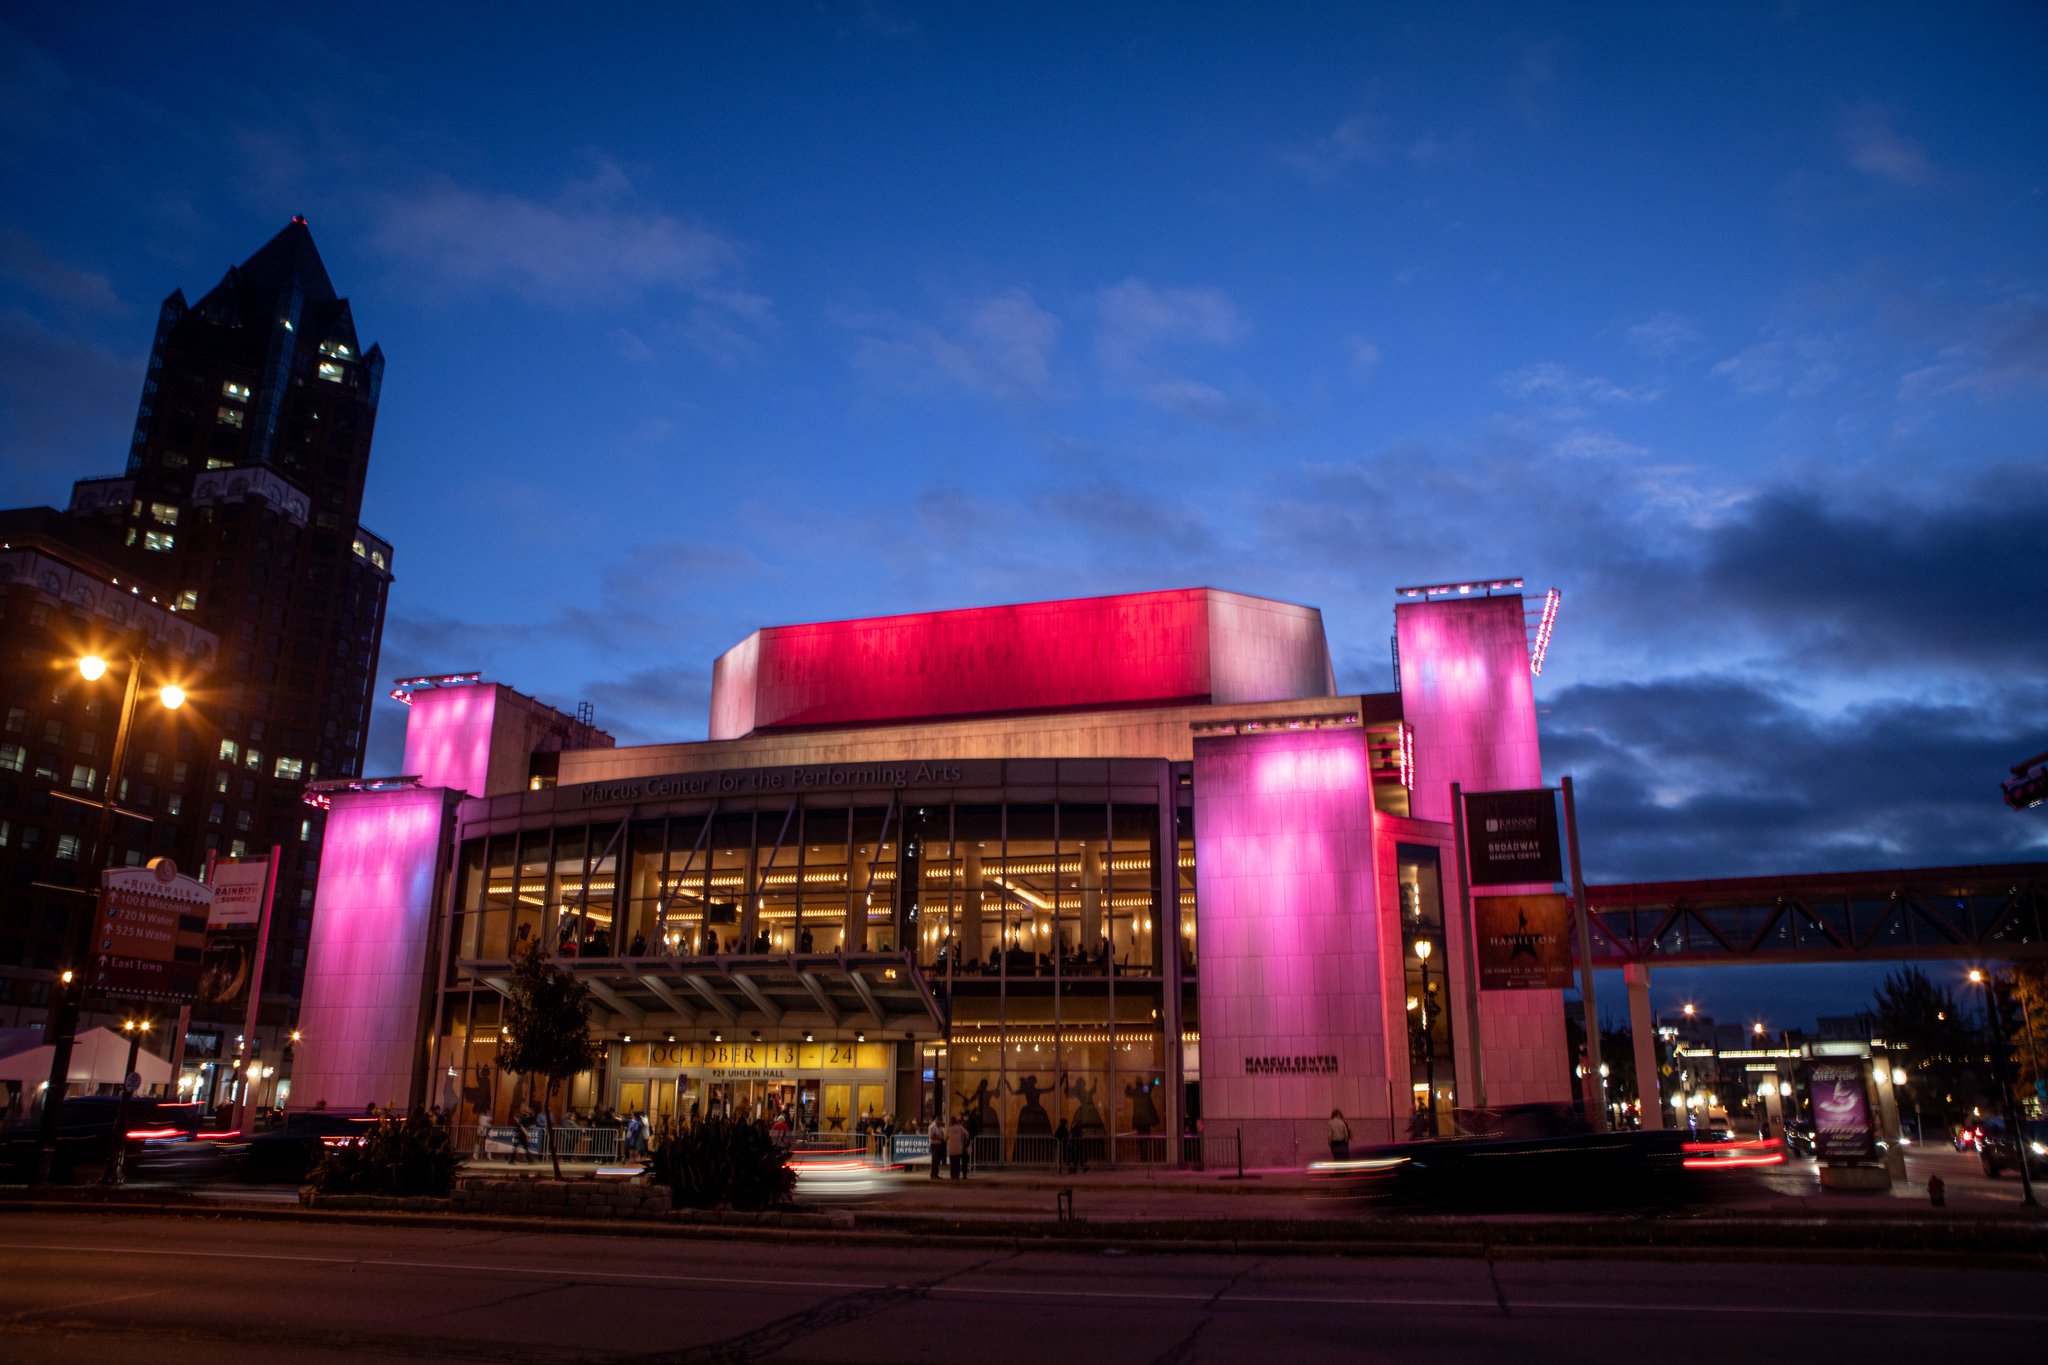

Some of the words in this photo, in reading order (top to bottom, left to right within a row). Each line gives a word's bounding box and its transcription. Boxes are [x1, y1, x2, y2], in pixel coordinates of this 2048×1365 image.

[580, 783, 641, 803] Marcus
[647, 777, 711, 797] Center
[717, 772, 745, 790] for
[751, 769, 784, 789] the
[791, 765, 908, 788] Performing
[915, 761, 961, 781] Arts
[1488, 841, 1539, 852] BROADWAY
[1489, 853, 1515, 861] MARCUS
[1517, 852, 1541, 860] CENTER
[131, 879, 192, 898] RIVERWALK
[215, 887, 260, 896] RAINBOW
[121, 894, 139, 906] 100
[140, 896, 147, 907] E
[148, 898, 191, 913] Wisconsin
[119, 909, 137, 920] 720
[138, 911, 146, 922] N
[147, 912, 174, 926] Water
[115, 925, 134, 937] 525
[136, 927, 144, 938] N
[145, 928, 172, 941] Water
[1490, 936, 1557, 946] HAMILTON
[110, 957, 134, 969] East
[136, 960, 163, 973] Town
[652, 1047, 757, 1064] OCTOBER
[773, 1047, 794, 1063] 13
[829, 1047, 853, 1063] 24
[1245, 1056, 1291, 1066] MARCUS
[1294, 1056, 1338, 1065] CENTER
[728, 1069, 761, 1078] UIHLEIN
[763, 1069, 785, 1077] HALL
[1812, 1073, 1835, 1081] SHEN
[1837, 1073, 1857, 1081] YUN
[896, 1139, 930, 1147] PERFORM
